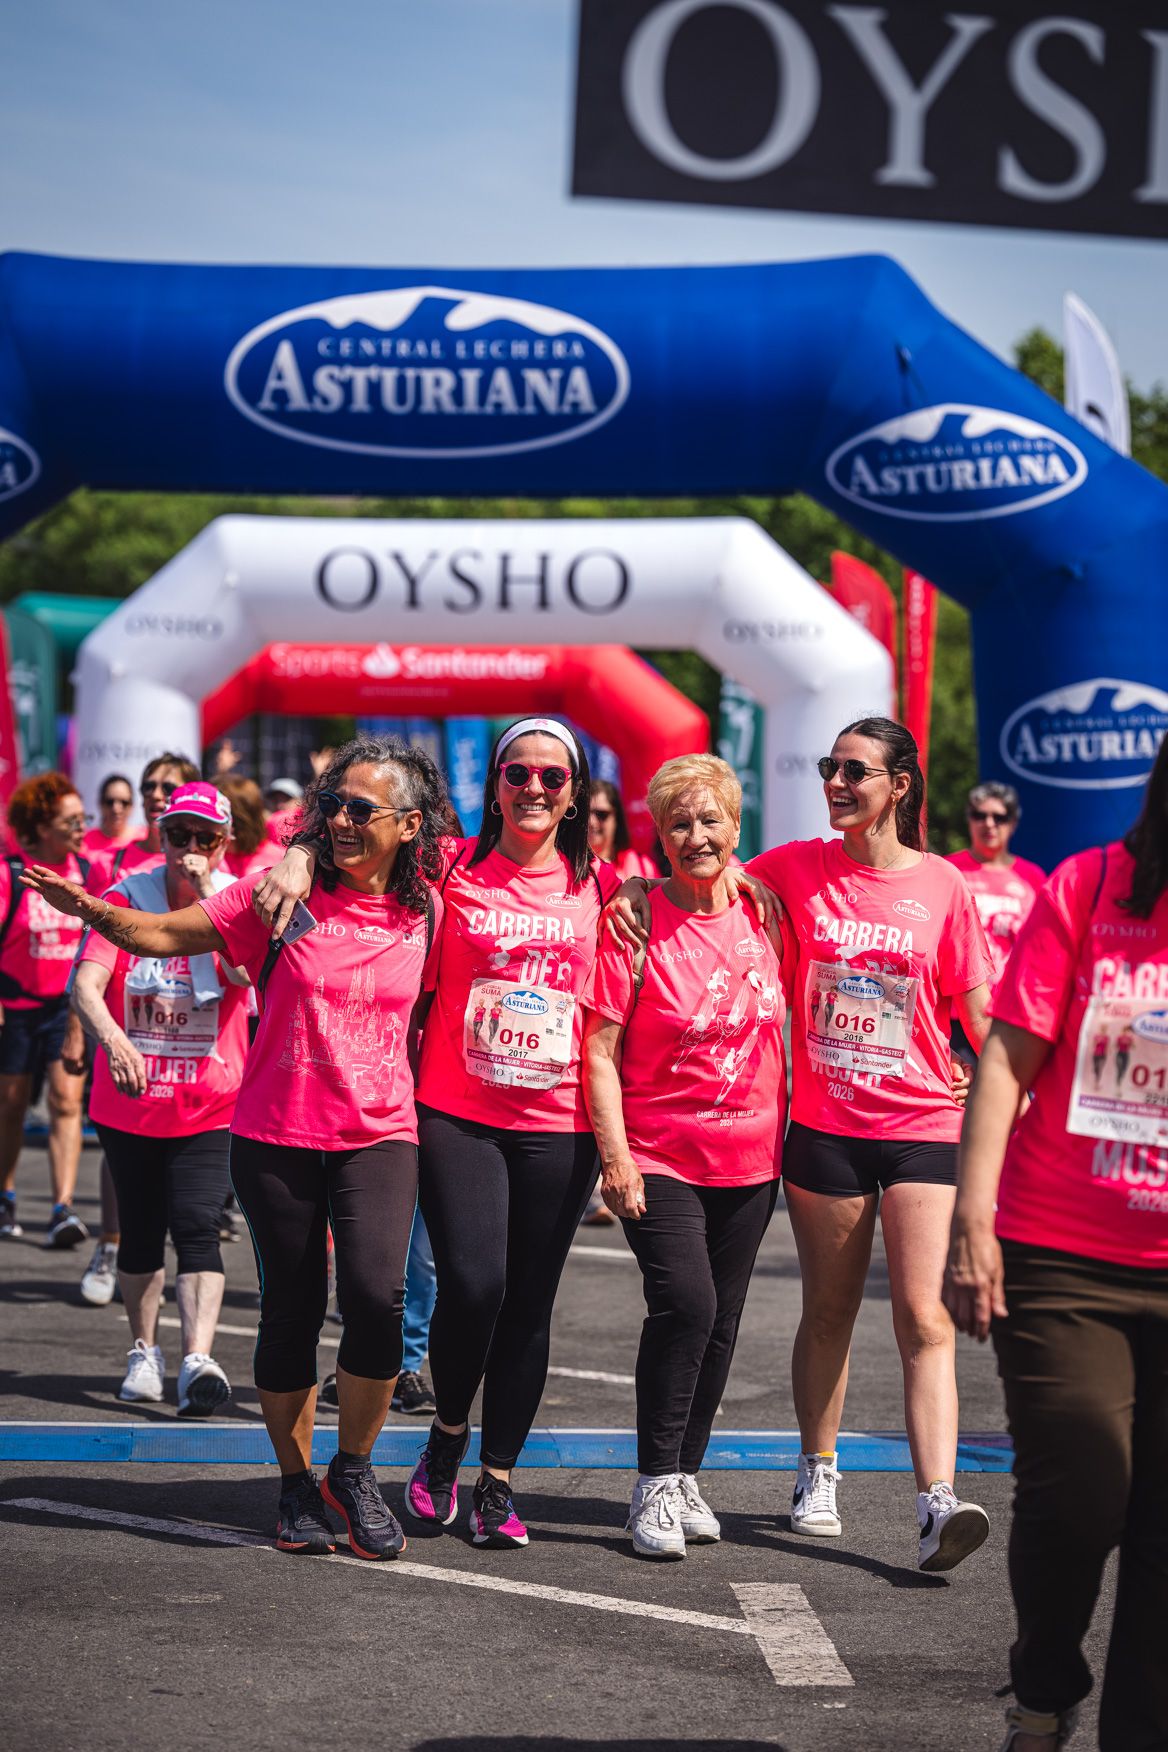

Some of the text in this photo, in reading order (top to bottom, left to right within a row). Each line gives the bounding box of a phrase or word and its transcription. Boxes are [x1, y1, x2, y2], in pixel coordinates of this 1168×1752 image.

[317, 338, 586, 360] CENTRAL LECHERA
[257, 338, 598, 415] ASTURIANA
[850, 452, 1071, 496] ASTURIANA
[314, 544, 633, 615] OYSHO
[401, 647, 548, 680] Santander
[465, 890, 511, 900] OYSHO
[817, 889, 858, 904] OYSHO
[896, 903, 928, 919] ASTURIANA
[468, 909, 576, 944] CARRERA
[813, 915, 913, 957] CARRERA
[659, 948, 703, 963] OYSHO
[481, 987, 502, 997] SUMA
[841, 981, 881, 996] ASTURIANA
[505, 995, 546, 1012] ASTURIANA
[155, 1011, 188, 1026] 016
[835, 1012, 876, 1034] 016
[499, 1028, 540, 1050] 016
[839, 1042, 856, 1050] MUJER
[844, 1033, 864, 1043] 2018
[508, 1048, 528, 1059] 2017
[811, 1045, 840, 1061] OYSHO
[146, 1056, 197, 1084] UJER
[475, 1062, 505, 1077] OYSHO
[860, 1056, 892, 1069] Santander
[149, 1084, 175, 1098] 2026
[827, 1081, 855, 1102] 2026
[696, 1110, 721, 1119] CARRERA
[722, 1111, 730, 1119] DE
[730, 1111, 737, 1119] LA
